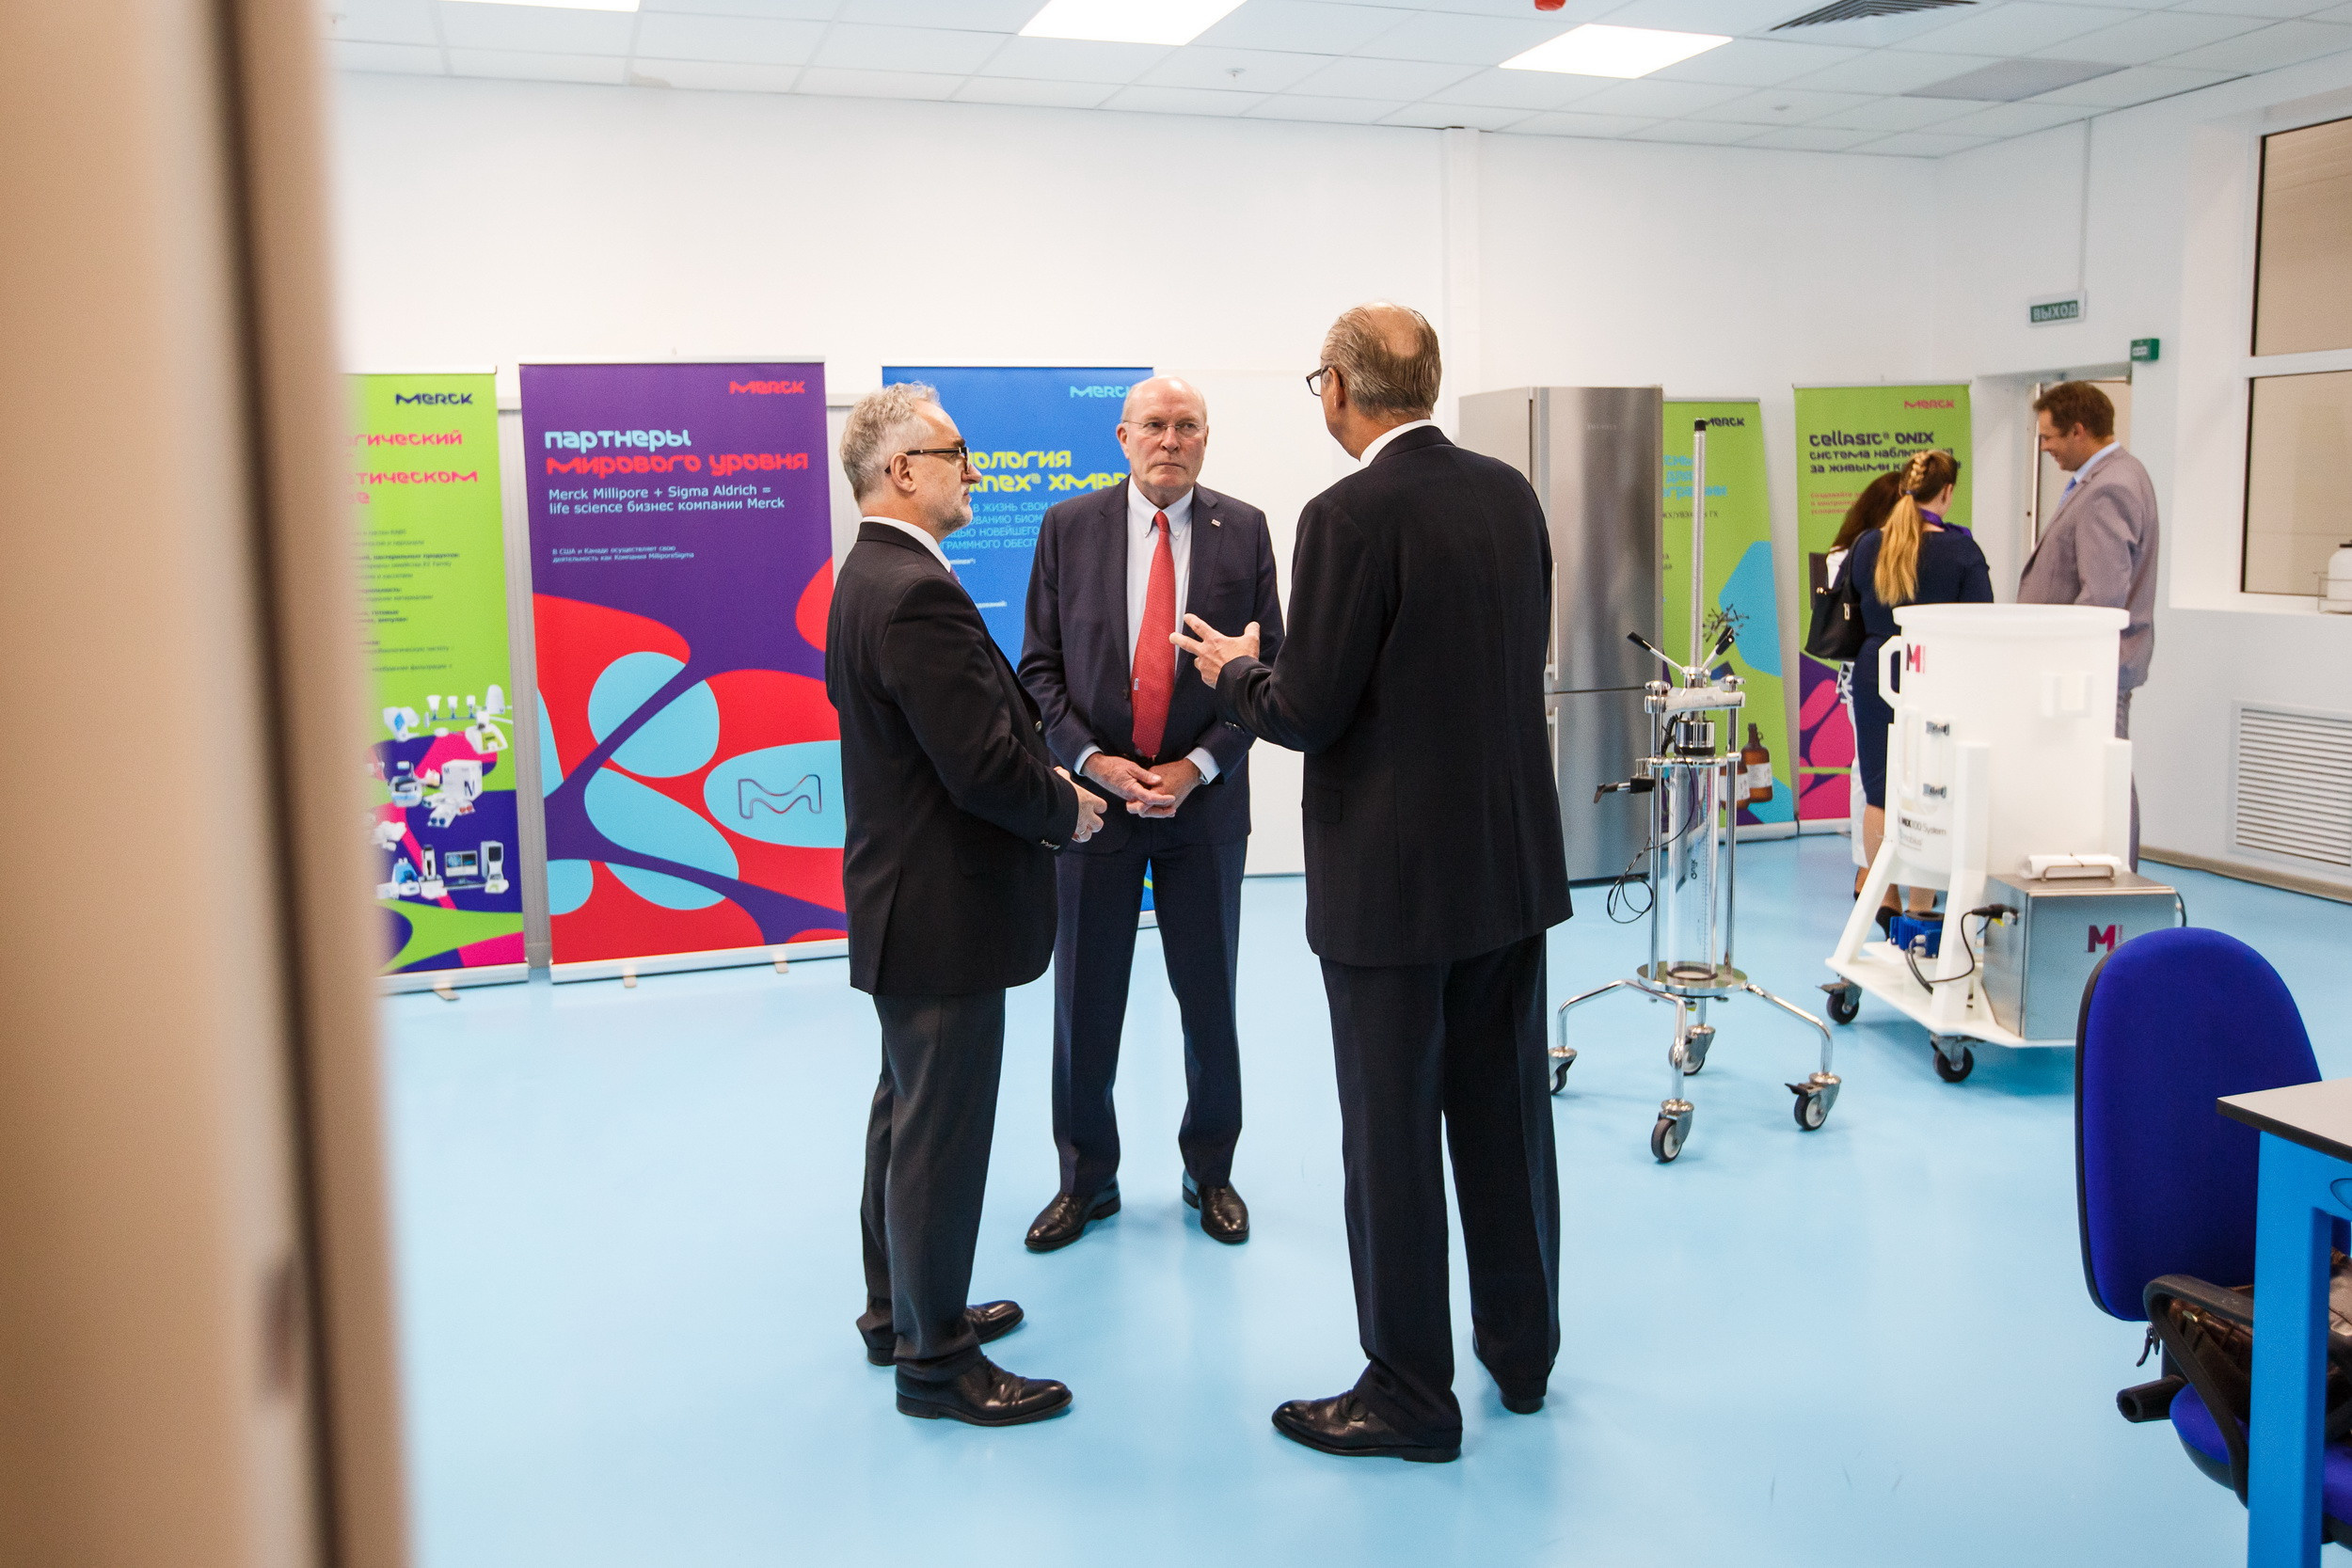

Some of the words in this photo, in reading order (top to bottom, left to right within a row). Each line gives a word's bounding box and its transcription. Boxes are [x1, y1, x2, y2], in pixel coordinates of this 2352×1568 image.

[2032, 302, 2078, 321] ВЫХОД
[354, 429, 463, 446] гический
[544, 429, 691, 453] партнеры
[1895, 432, 1934, 445] ONIX
[969, 451, 1072, 469] ология
[1809, 450, 1870, 460] система
[546, 454, 701, 479] мирового
[708, 452, 809, 476] уровня
[1810, 464, 1824, 473] за
[1829, 463, 1890, 473] живыми
[356, 470, 478, 484] тическом
[548, 488, 589, 501] Merck
[593, 487, 648, 502] Millipore
[668, 485, 708, 499] Sigma
[713, 484, 757, 497] Aldrich
[549, 502, 570, 515] life
[574, 501, 623, 514] science
[627, 499, 675, 512] бизнес
[677, 499, 743, 511] компании
[747, 497, 786, 509] Merck
[982, 502, 1018, 513] ЖИЗНЬ
[1021, 501, 1048, 512] СВОИ
[971, 515, 1011, 525] ОВАНИЮ
[979, 525, 1040, 536] НОВЕЙШЕГО
